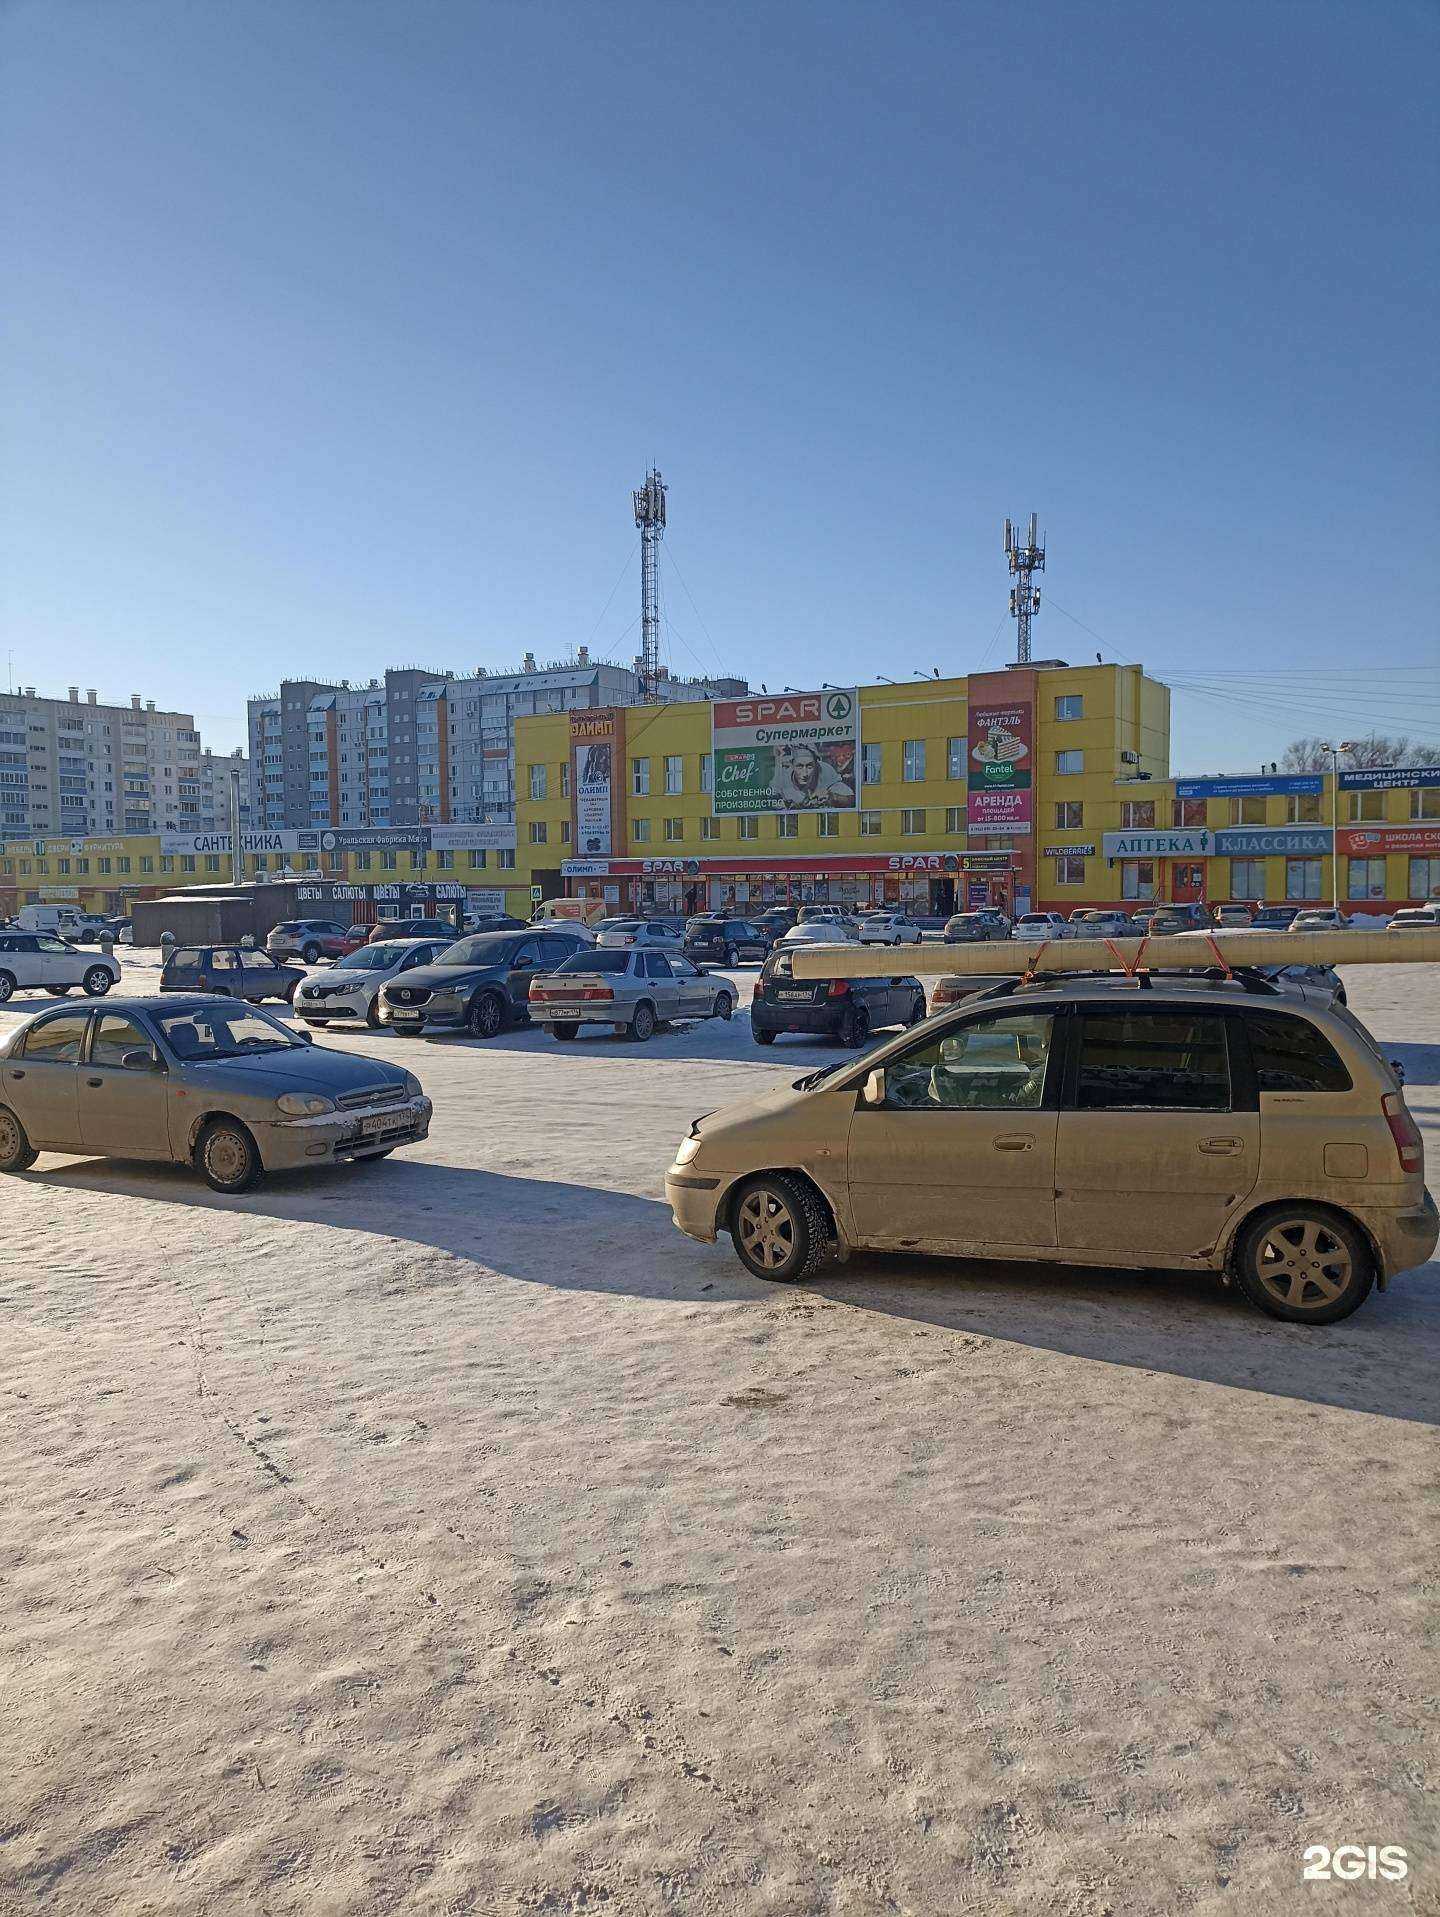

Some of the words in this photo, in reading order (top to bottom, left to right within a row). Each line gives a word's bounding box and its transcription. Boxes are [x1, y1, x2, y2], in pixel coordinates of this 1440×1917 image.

[735, 700, 819, 723] SPAR
[977, 716, 1021, 727] ФАНТЭЛЬ
[755, 725, 852, 743] Супермаркет
[985, 765, 1013, 774] Fantel
[1373, 779, 1419, 788] ЦЕНТР
[578, 786, 609, 795] ОЛИМП
[715, 798, 785, 809] ПРОИЗВОДСТВО
[974, 795, 1023, 807] АРЕНДА
[338, 836, 375, 845] Уральская
[376, 835, 407, 845] Фабрика
[1385, 833, 1422, 841] ШКОЛА
[1116, 837, 1194, 853] АПТЕКА
[1221, 836, 1329, 851] КЛАССИКА
[1045, 846, 1094, 856] WILDBERRIES
[642, 860, 684, 873] SPAR
[888, 856, 940, 870] SPAR
[297, 887, 323, 900] ЦВЕТЫ
[332, 887, 366, 900] САЛЮТЫ
[373, 885, 400, 899] ЦВЕТЫ
[435, 886, 467, 899] САЛЮТЫ
